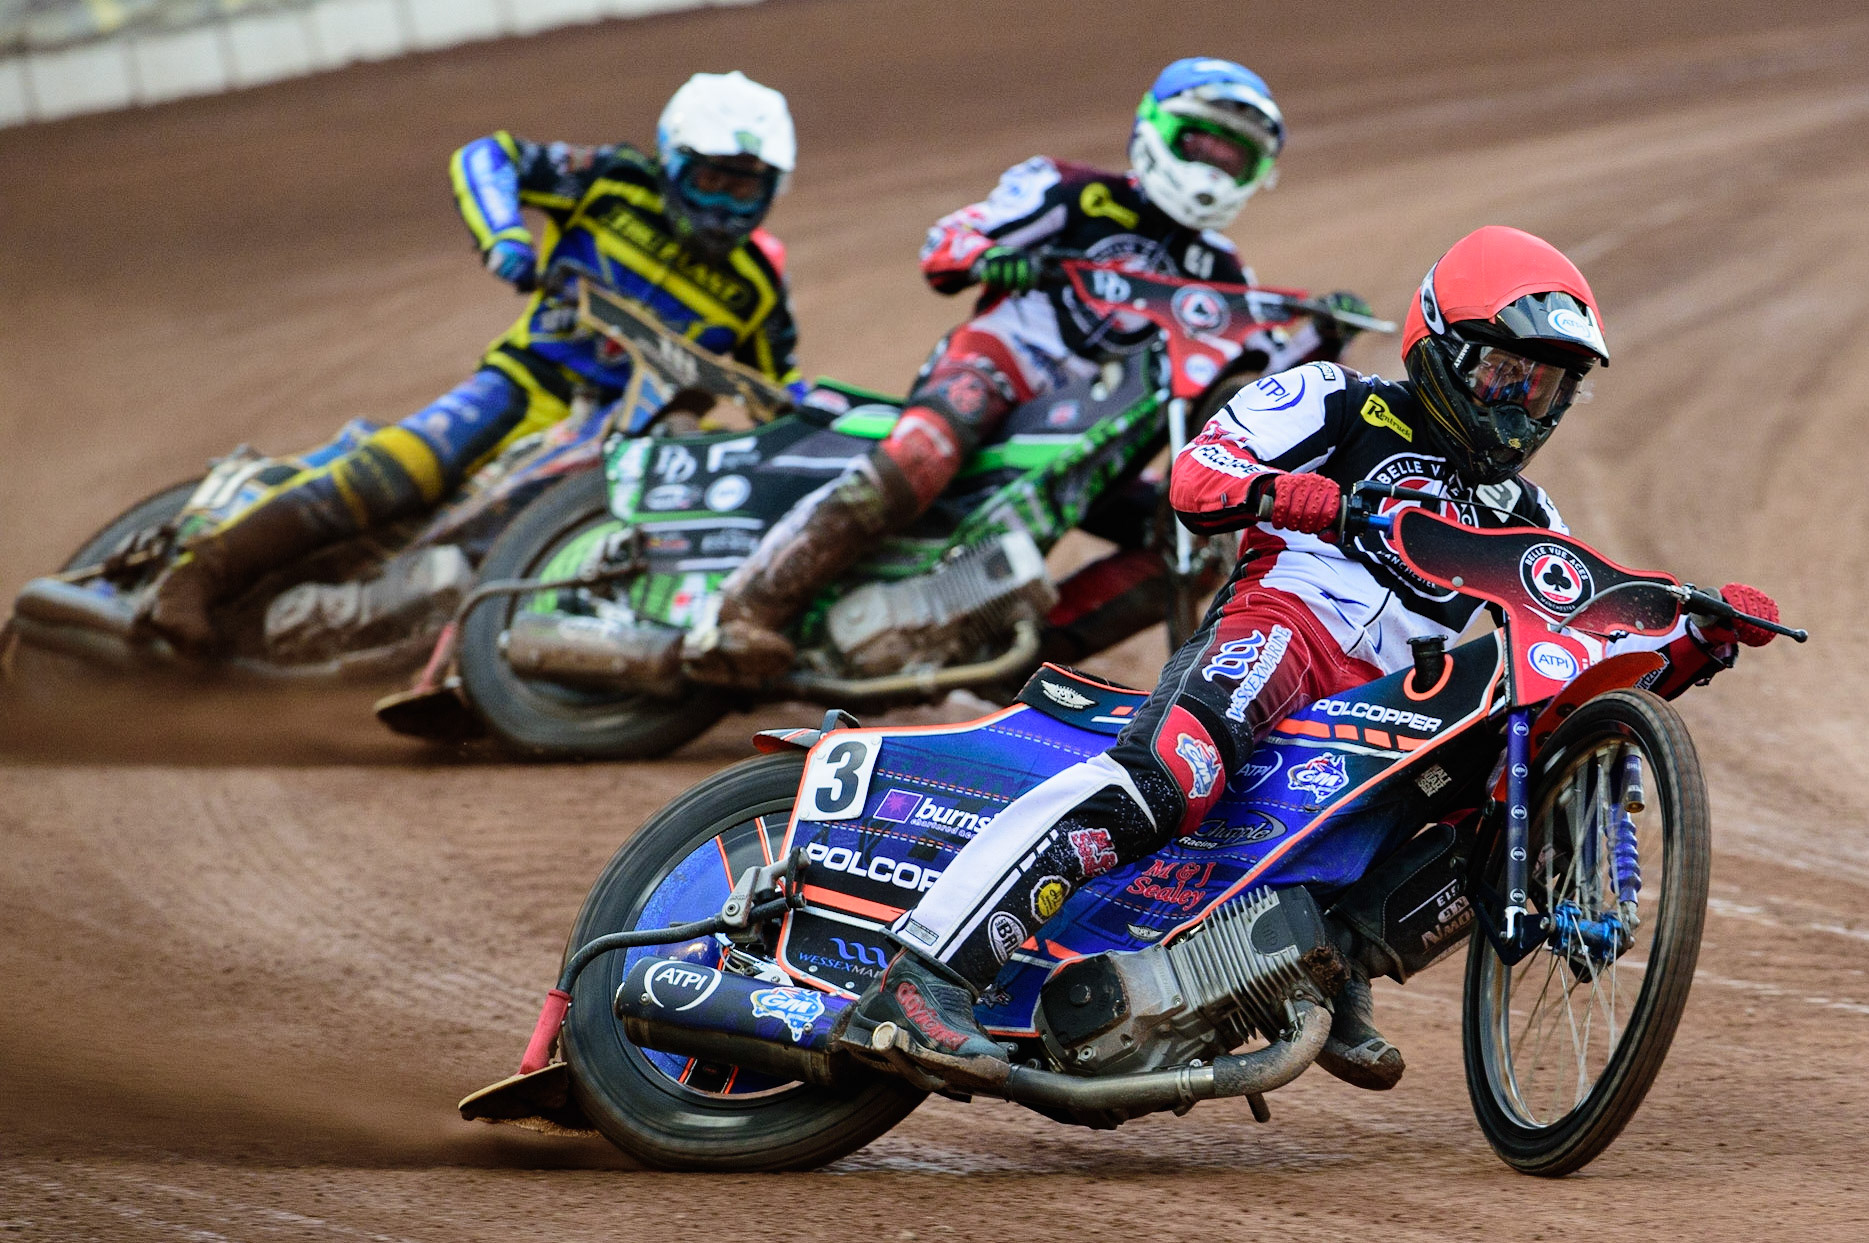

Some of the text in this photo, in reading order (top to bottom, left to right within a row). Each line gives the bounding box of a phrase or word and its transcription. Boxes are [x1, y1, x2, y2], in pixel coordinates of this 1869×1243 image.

[1368, 398, 1412, 439] Rentruck
[1376, 460, 1424, 485] BELLE
[1524, 546, 1589, 581] BELLE VUE ACES
[1540, 596, 1576, 611] MANCHESTER
[1229, 626, 1290, 719] WESSEXMARINE
[1537, 653, 1570, 669] ATPI
[1311, 698, 1443, 733] POLCOPPER
[814, 740, 868, 814] 3
[1235, 762, 1272, 777] ATPI
[1295, 769, 1340, 786] GM
[1178, 836, 1219, 850] Racing
[1141, 858, 1217, 888] M & J
[1126, 876, 1206, 911] Sealey
[655, 967, 708, 990] ATPI
[760, 994, 813, 1013] GM
